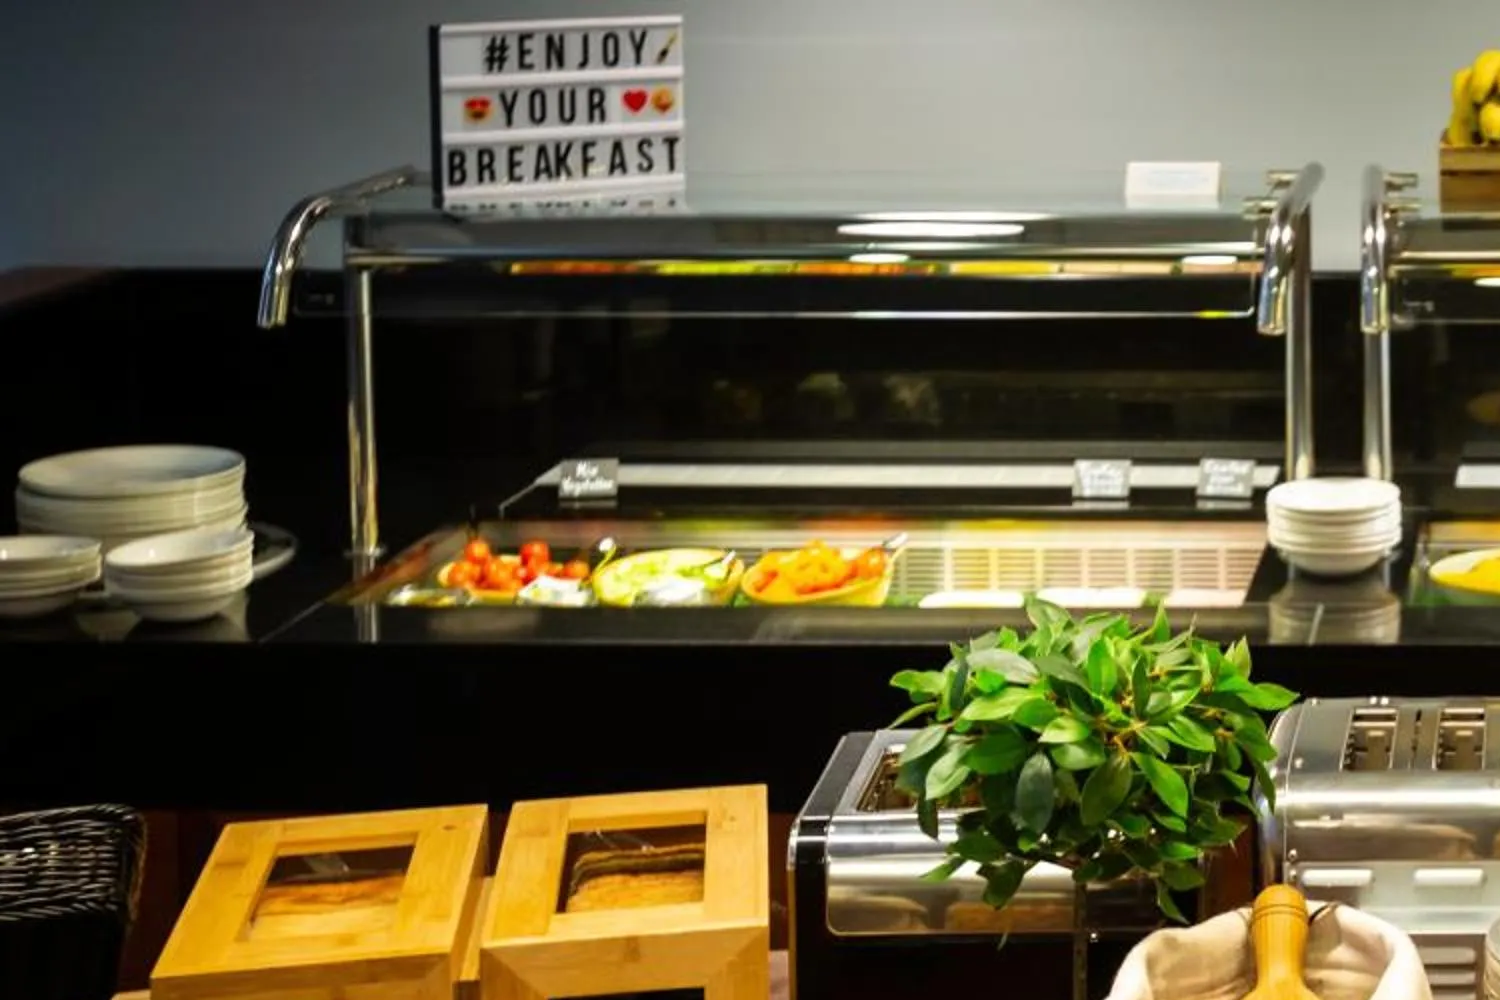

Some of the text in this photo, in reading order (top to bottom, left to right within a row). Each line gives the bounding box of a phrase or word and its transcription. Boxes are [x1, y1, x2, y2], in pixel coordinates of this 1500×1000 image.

[484, 28, 648, 73] #ENJOY
[499, 86, 607, 128] YOUR
[447, 136, 680, 187] BREAKFAST
